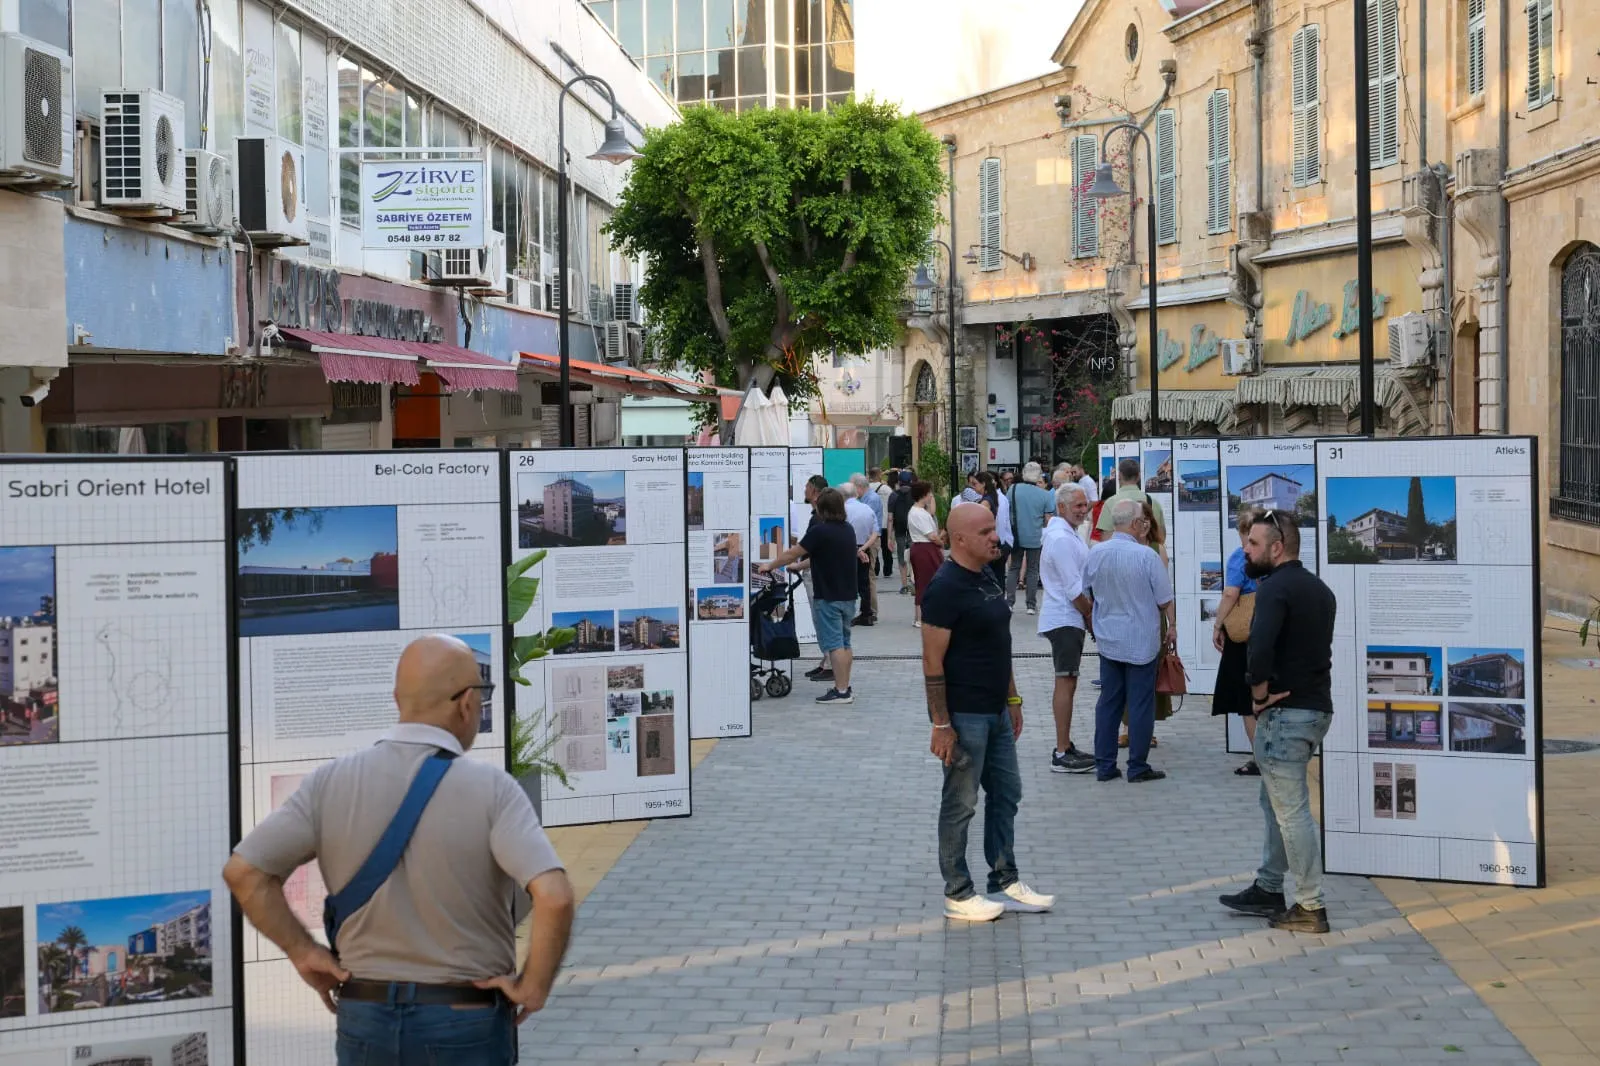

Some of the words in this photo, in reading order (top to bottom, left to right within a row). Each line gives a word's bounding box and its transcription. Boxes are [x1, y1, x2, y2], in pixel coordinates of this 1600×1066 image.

[405, 167, 475, 184] ZİRVE
[415, 184, 475, 197] sigorta
[376, 212, 424, 223] SABRİYE
[426, 212, 472, 222] ÖZETEM
[387, 234, 411, 243] 0548
[413, 234, 431, 243] 849
[434, 234, 445, 242] 87
[448, 234, 461, 242] 82
[1179, 442, 1188, 451] 19
[1227, 444, 1240, 454] 25
[1495, 445, 1526, 455] Atleks
[631, 454, 655, 463] Saray
[656, 454, 678, 462] Hotel
[721, 452, 744, 460] building
[1329, 447, 1343, 460] 31
[375, 463, 433, 476] Bel-Cola
[438, 462, 490, 476] Factory
[8, 479, 69, 498] Sabri
[77, 478, 146, 497] Orient
[154, 477, 210, 496] Hotel
[644, 799, 682, 809] 1959-1962
[1479, 863, 1527, 875] 1960-1962
